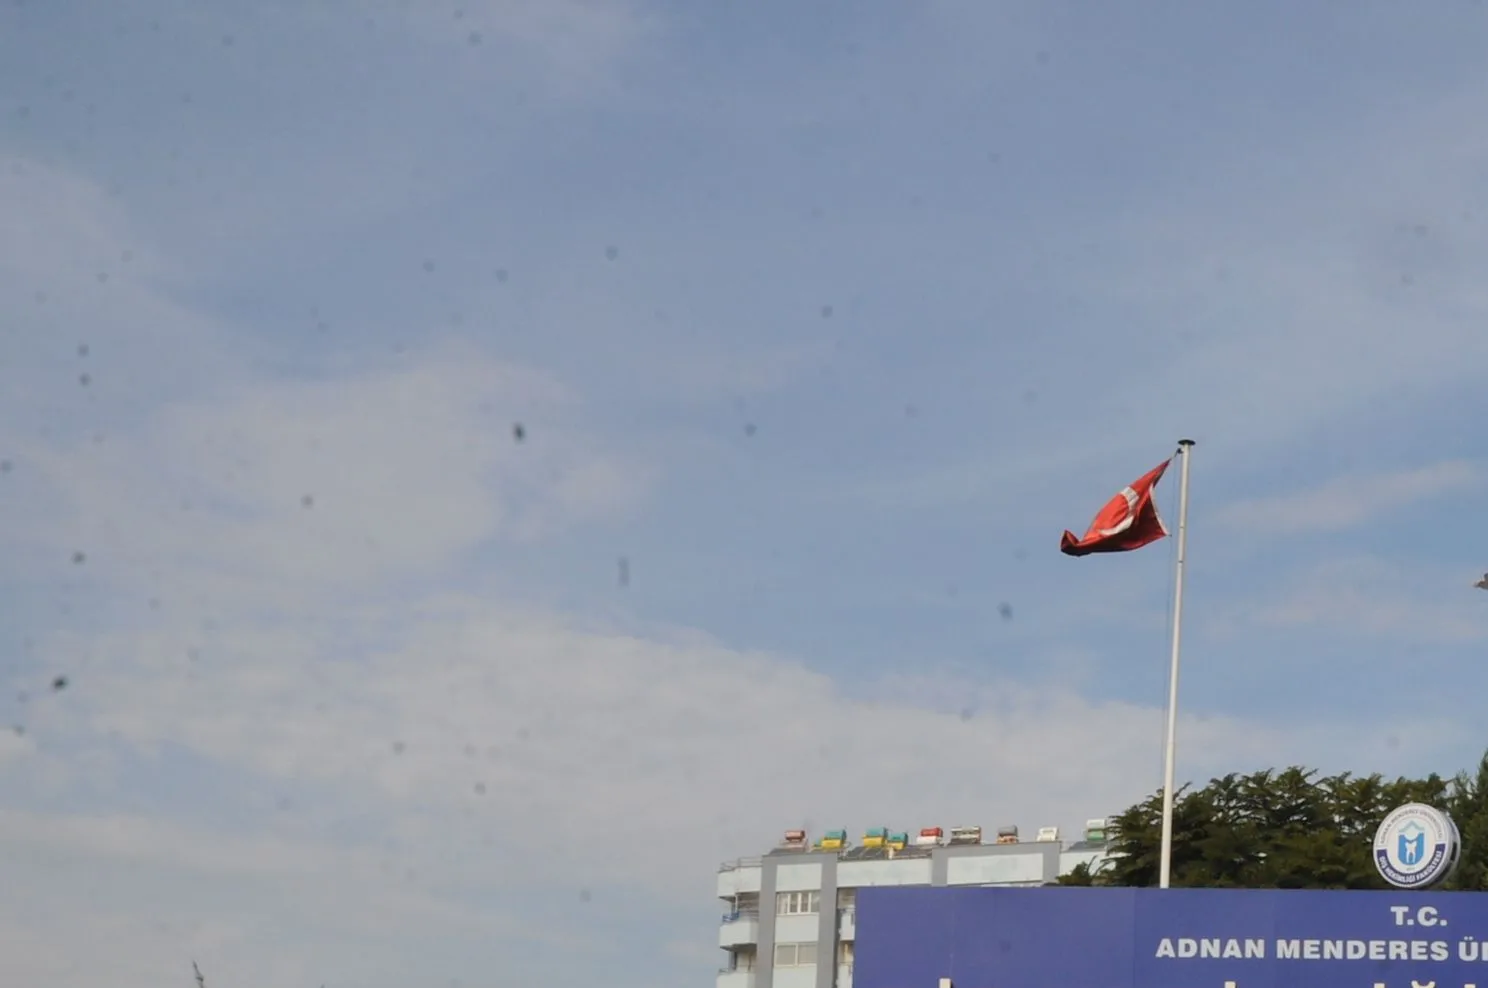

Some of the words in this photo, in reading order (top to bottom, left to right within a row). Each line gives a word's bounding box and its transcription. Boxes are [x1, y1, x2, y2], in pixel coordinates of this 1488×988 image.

[1390, 906, 1448, 927] T.C.
[1155, 938, 1265, 959] ADNAN
[1276, 939, 1449, 962] MENDERES
